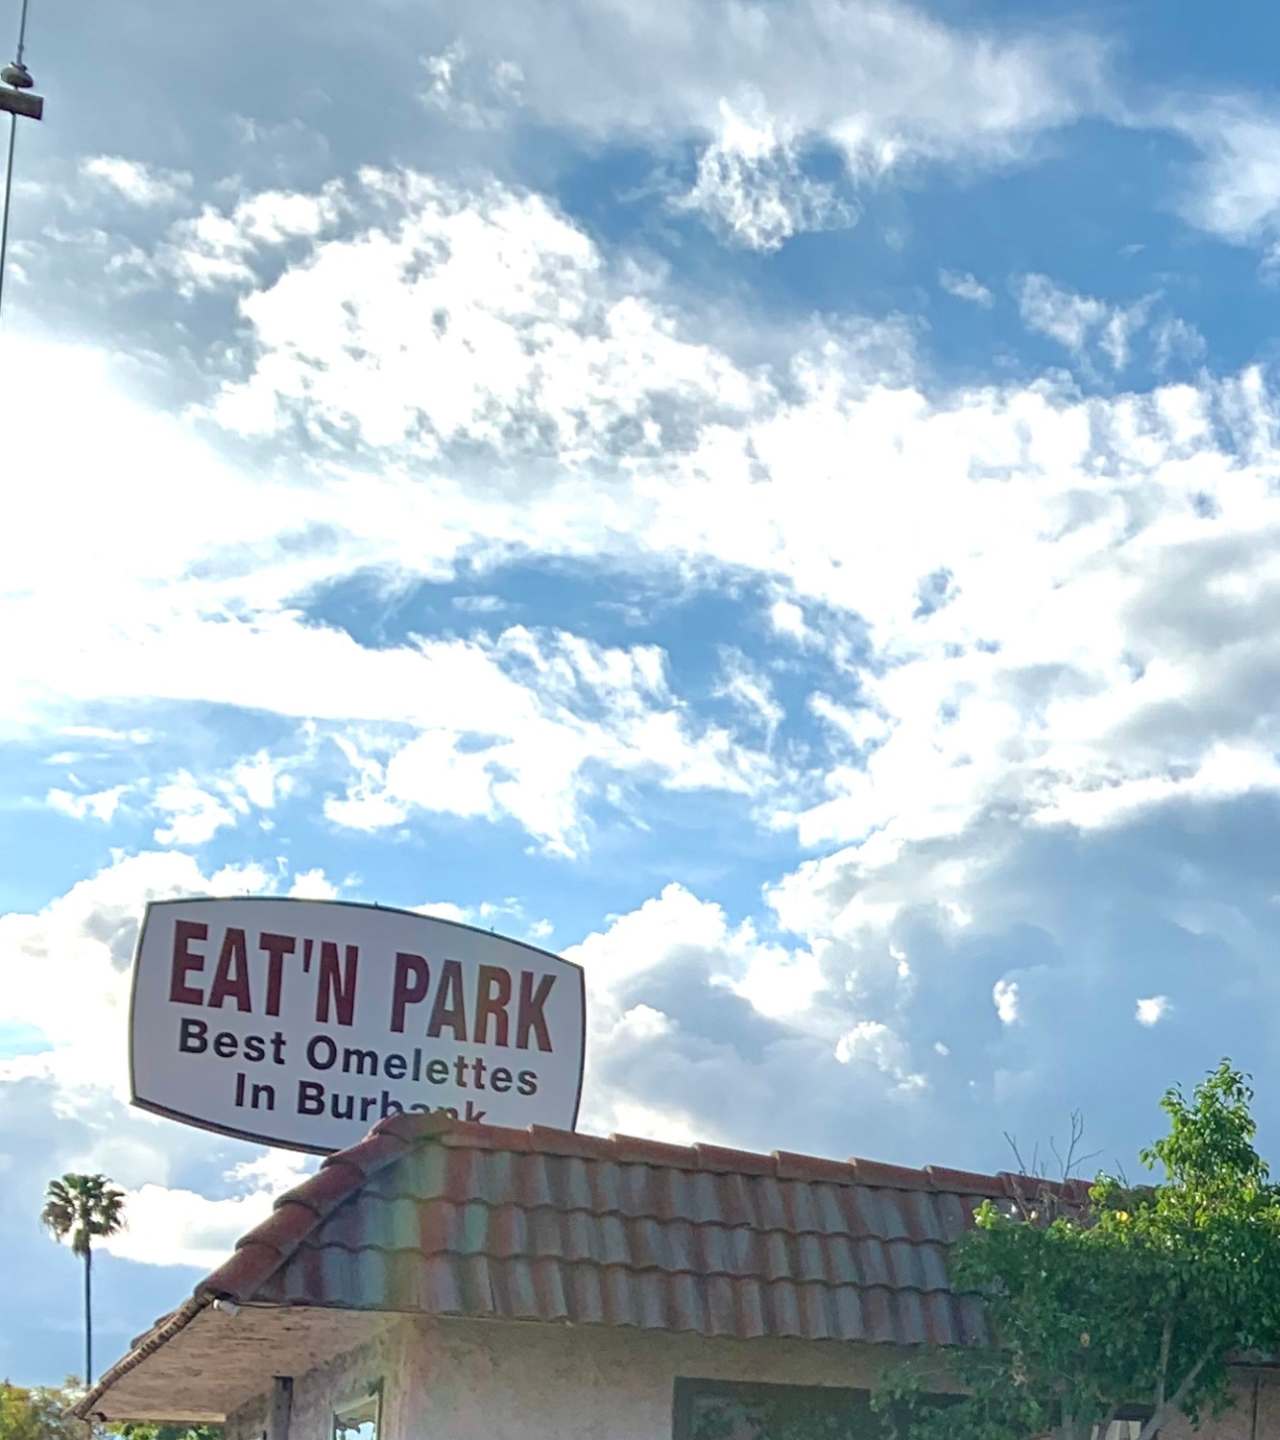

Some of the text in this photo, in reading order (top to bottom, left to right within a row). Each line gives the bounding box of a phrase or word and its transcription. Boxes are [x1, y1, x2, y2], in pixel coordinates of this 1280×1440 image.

[169, 920, 558, 1053] EAT'N PARK
[179, 1018, 539, 1096] Best Omelettes
[234, 1072, 276, 1111] In
